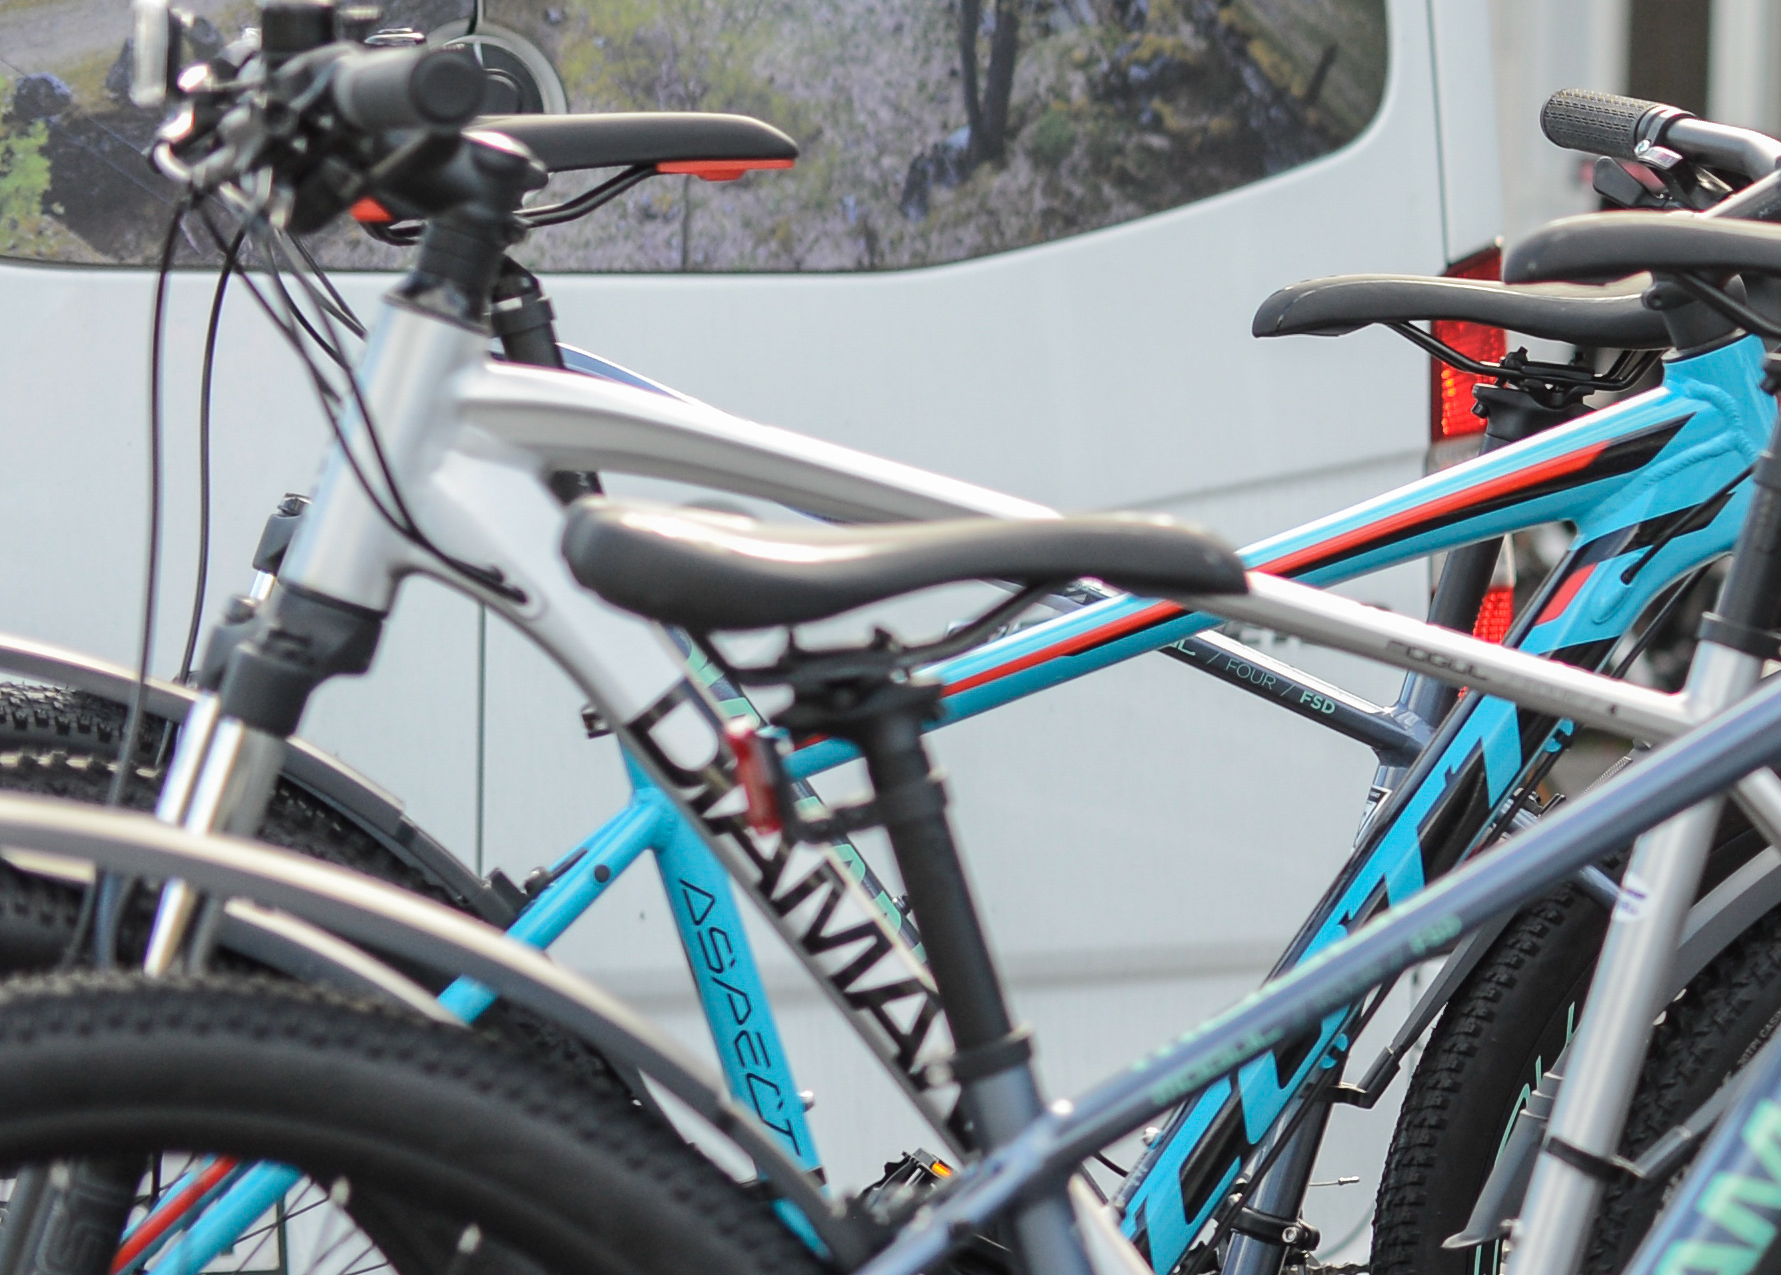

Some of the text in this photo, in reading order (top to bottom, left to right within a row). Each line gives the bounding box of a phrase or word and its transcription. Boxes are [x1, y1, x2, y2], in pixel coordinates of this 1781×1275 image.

[1225, 658, 1277, 690] FOUR
[1300, 690, 1336, 715] FSD
[679, 878, 801, 1157] ASPECT
